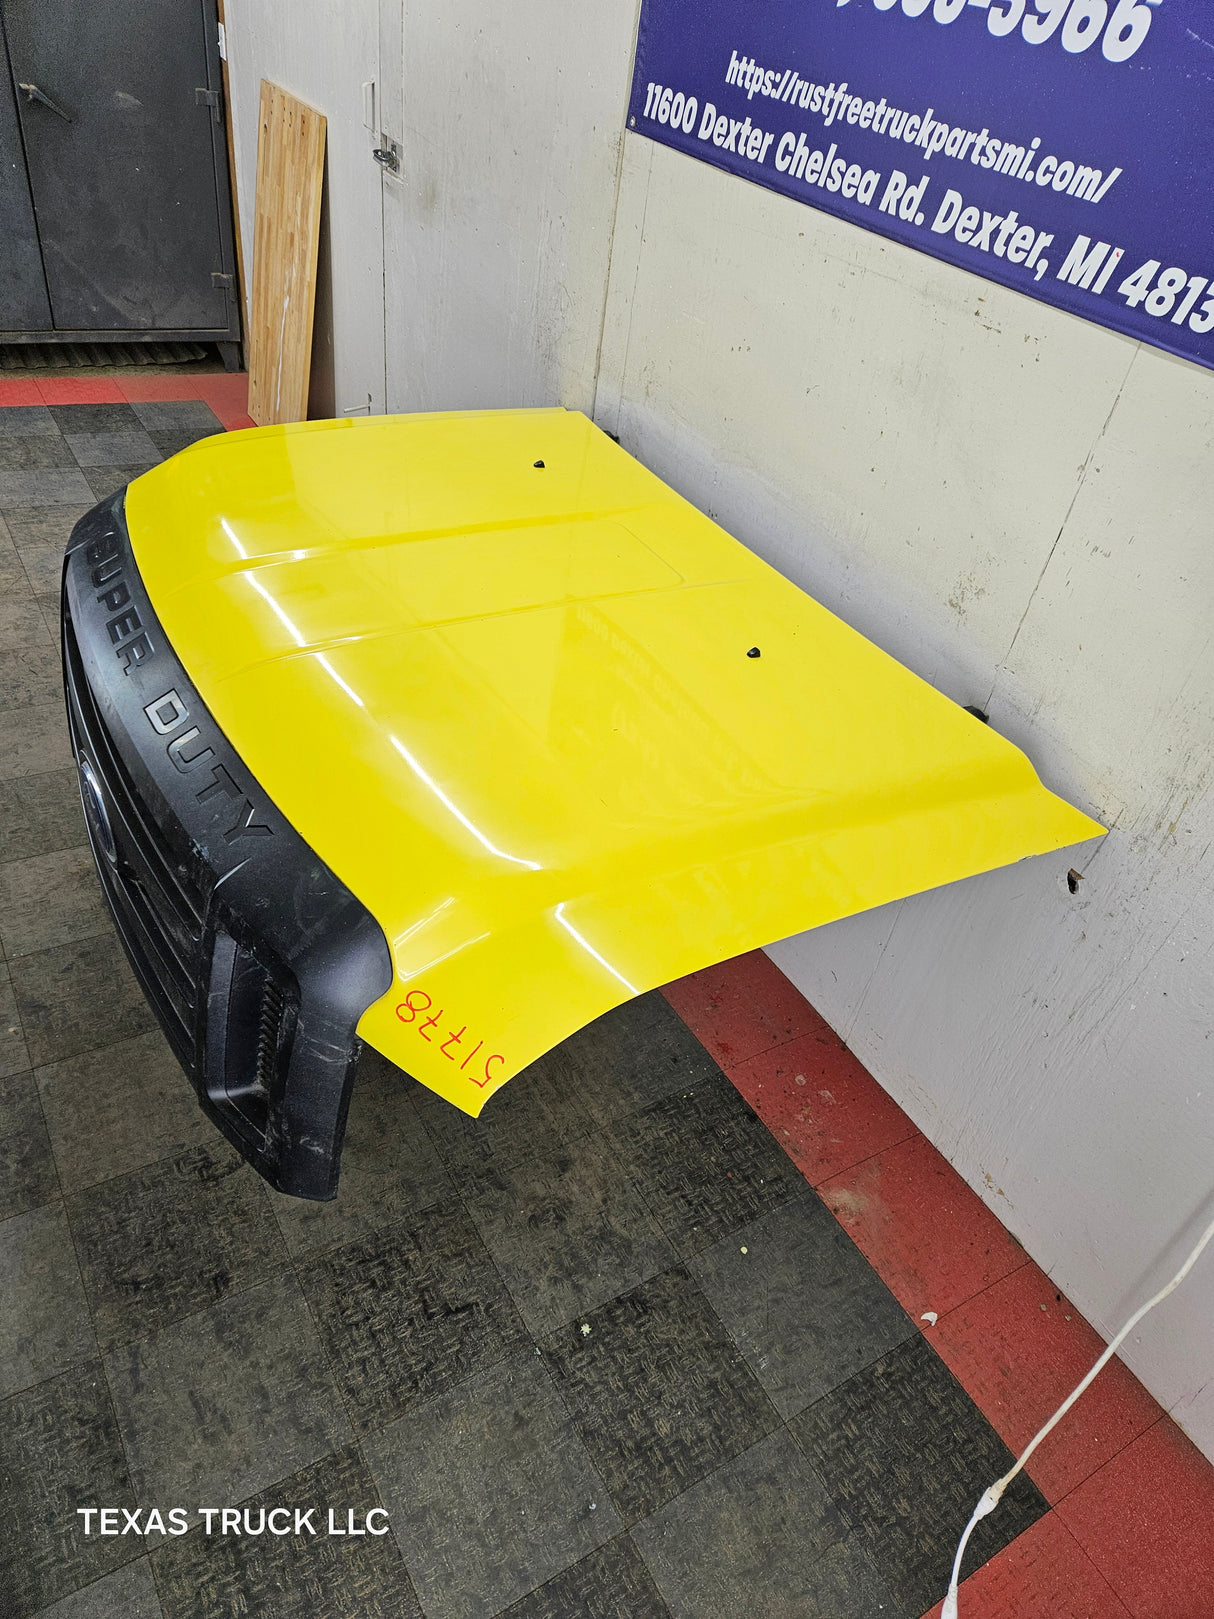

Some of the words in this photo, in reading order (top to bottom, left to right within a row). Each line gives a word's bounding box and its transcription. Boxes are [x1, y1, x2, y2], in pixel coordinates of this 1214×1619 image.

[643, 82, 698, 134] 11600
[697, 102, 775, 164] Dexter
[774, 131, 882, 207] Chelsea
[878, 169, 926, 226] Rd.
[930, 188, 1056, 282] Dexter,
[1056, 234, 1125, 295] MI
[725, 50, 1123, 204] https://rustfreetruckpartsmi.com/
[86, 530, 155, 677] SUPER
[143, 687, 275, 845] DUTY
[395, 989, 505, 1089] 51778
